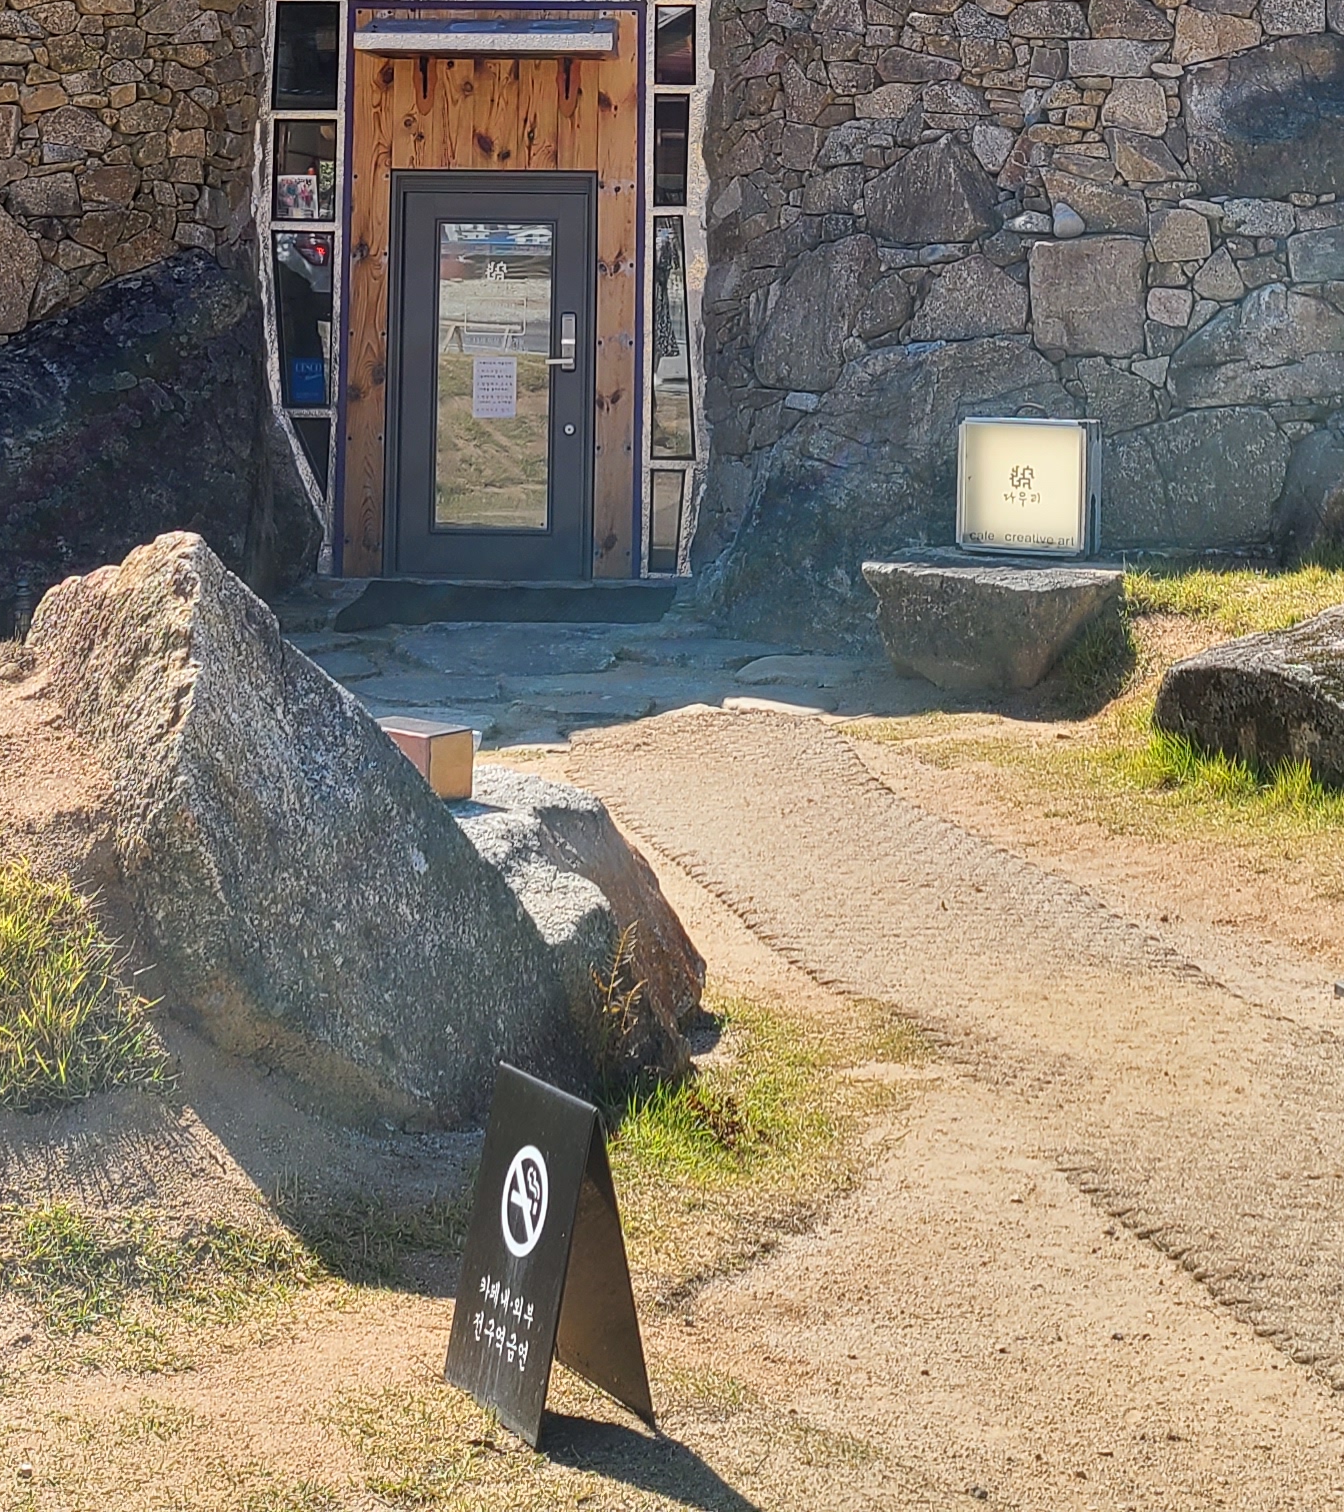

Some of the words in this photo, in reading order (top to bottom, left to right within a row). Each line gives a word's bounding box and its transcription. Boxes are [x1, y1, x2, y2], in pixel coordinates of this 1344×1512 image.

[969, 530, 995, 541] cafe
[1005, 533, 1054, 545] creative
[1057, 536, 1075, 547] art
